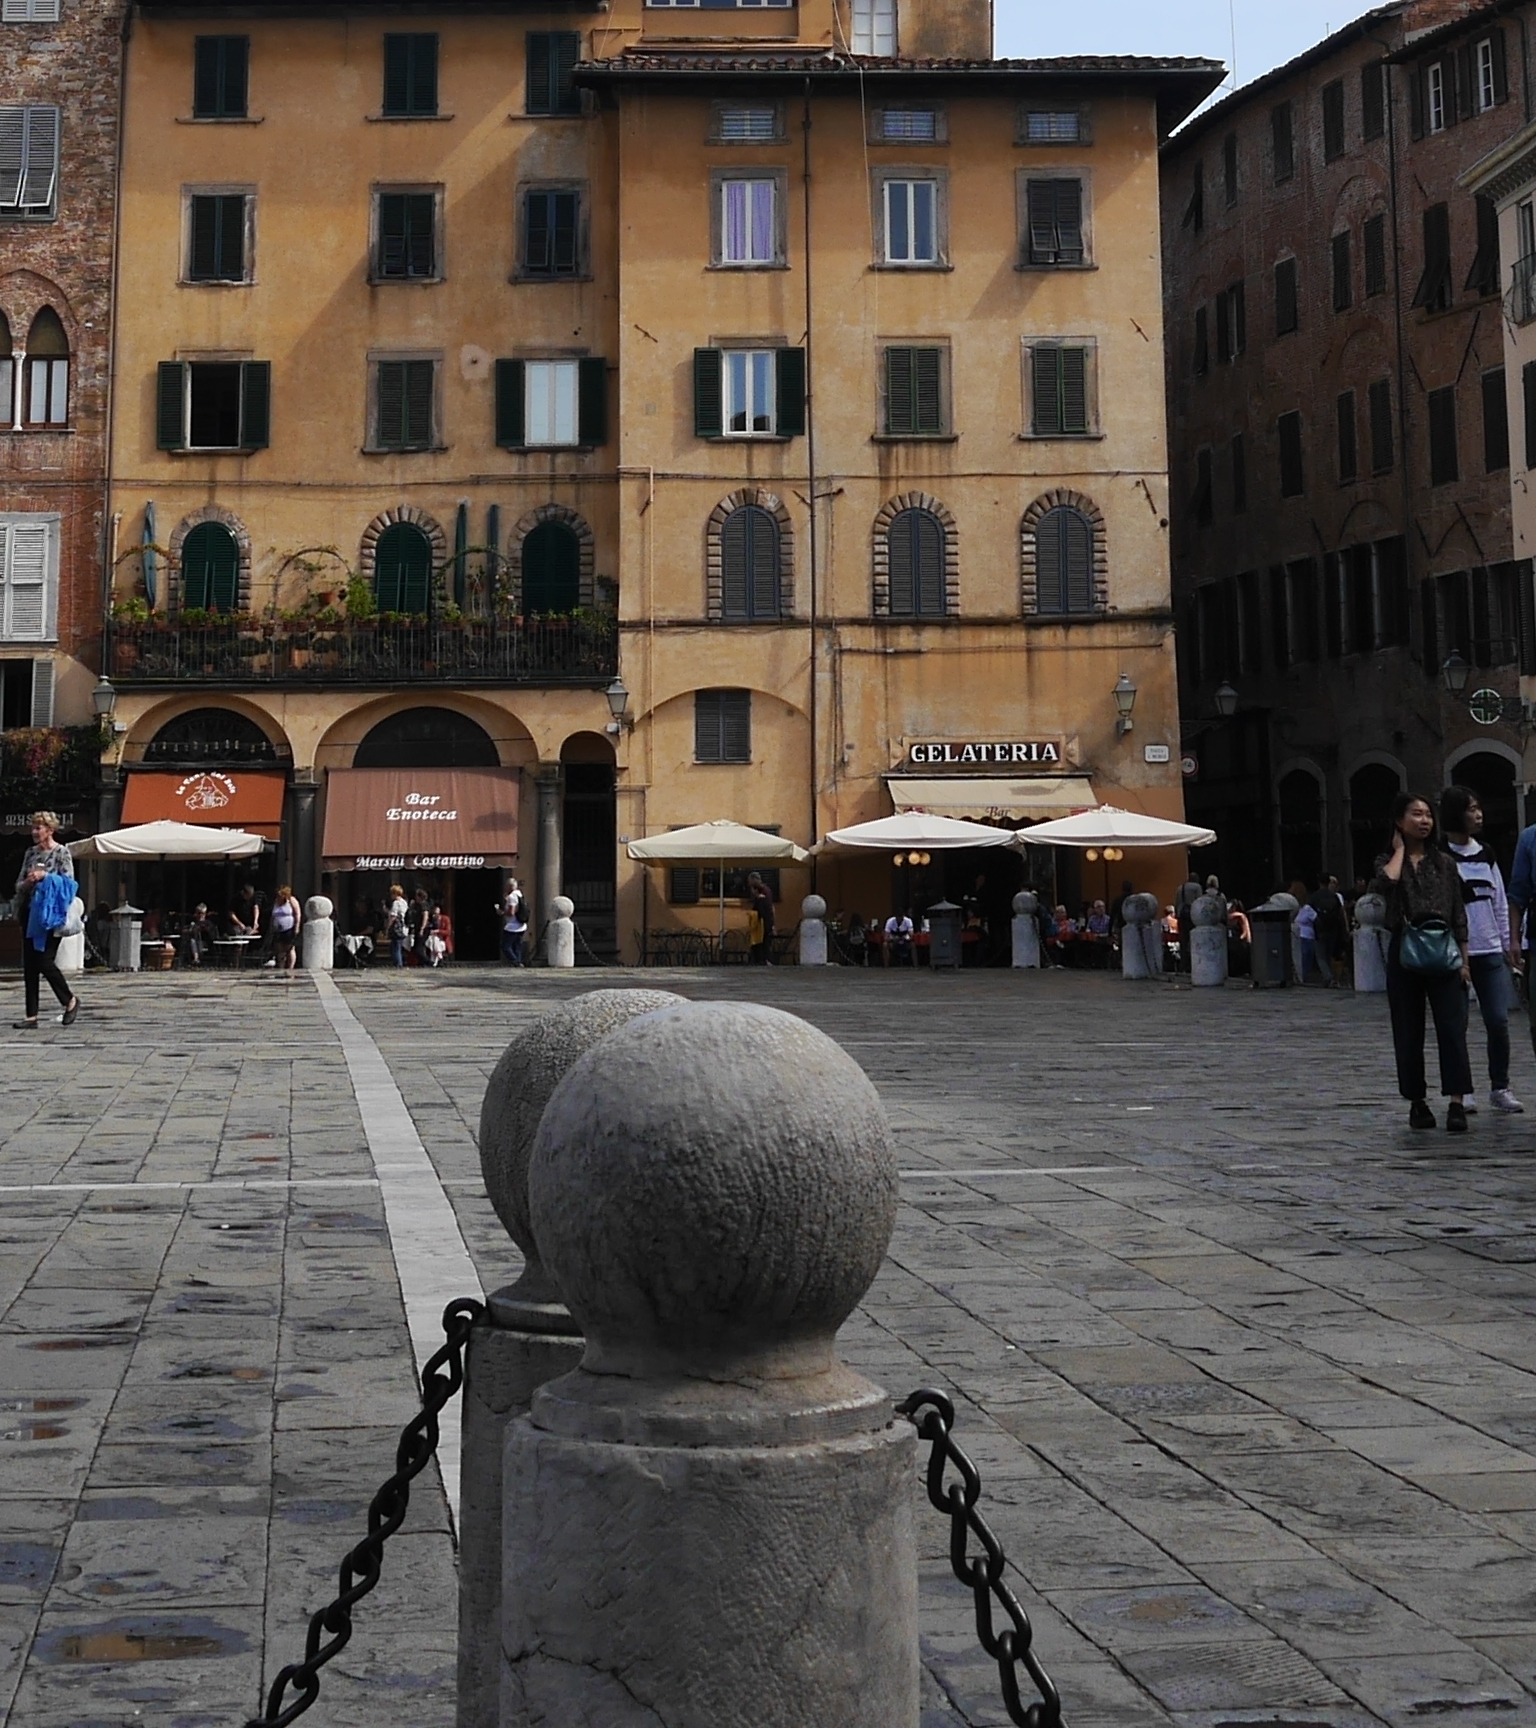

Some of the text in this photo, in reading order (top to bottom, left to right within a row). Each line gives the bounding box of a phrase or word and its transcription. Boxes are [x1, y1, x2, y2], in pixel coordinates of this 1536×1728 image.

[910, 743, 1059, 763] GELATERIA
[405, 792, 440, 805] Bar
[386, 808, 458, 821] Enoteca
[985, 806, 1011, 818] Bar
[5, 813, 74, 828] MASLI
[356, 854, 485, 868] Marsili Costantino
